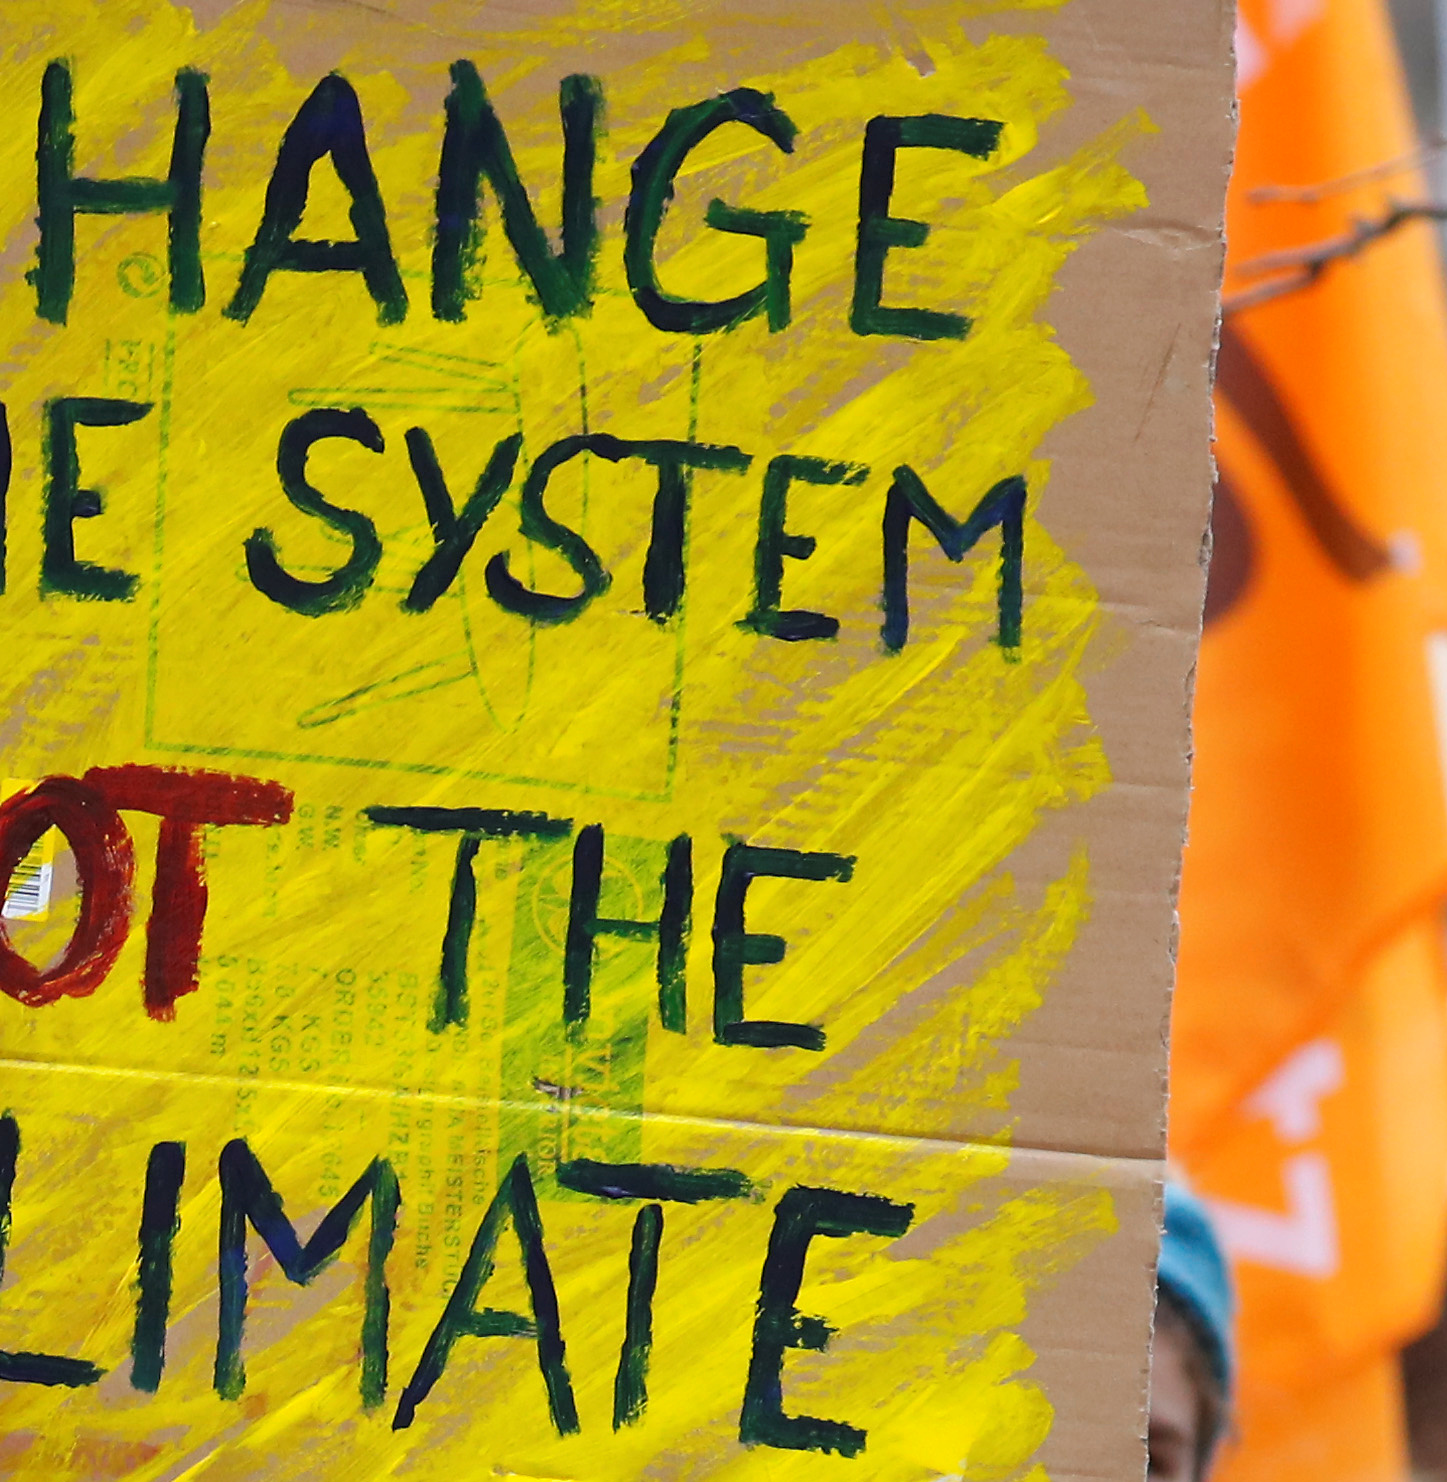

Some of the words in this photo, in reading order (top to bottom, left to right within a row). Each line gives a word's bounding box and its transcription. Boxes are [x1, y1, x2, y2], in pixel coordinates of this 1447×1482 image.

[242, 406, 1027, 662] SYSTEM
[363, 803, 858, 1051] THE
[268, 1014, 294, 1073] KGS
[298, 1014, 323, 1073] KGS
[328, 967, 358, 1064] ORDER
